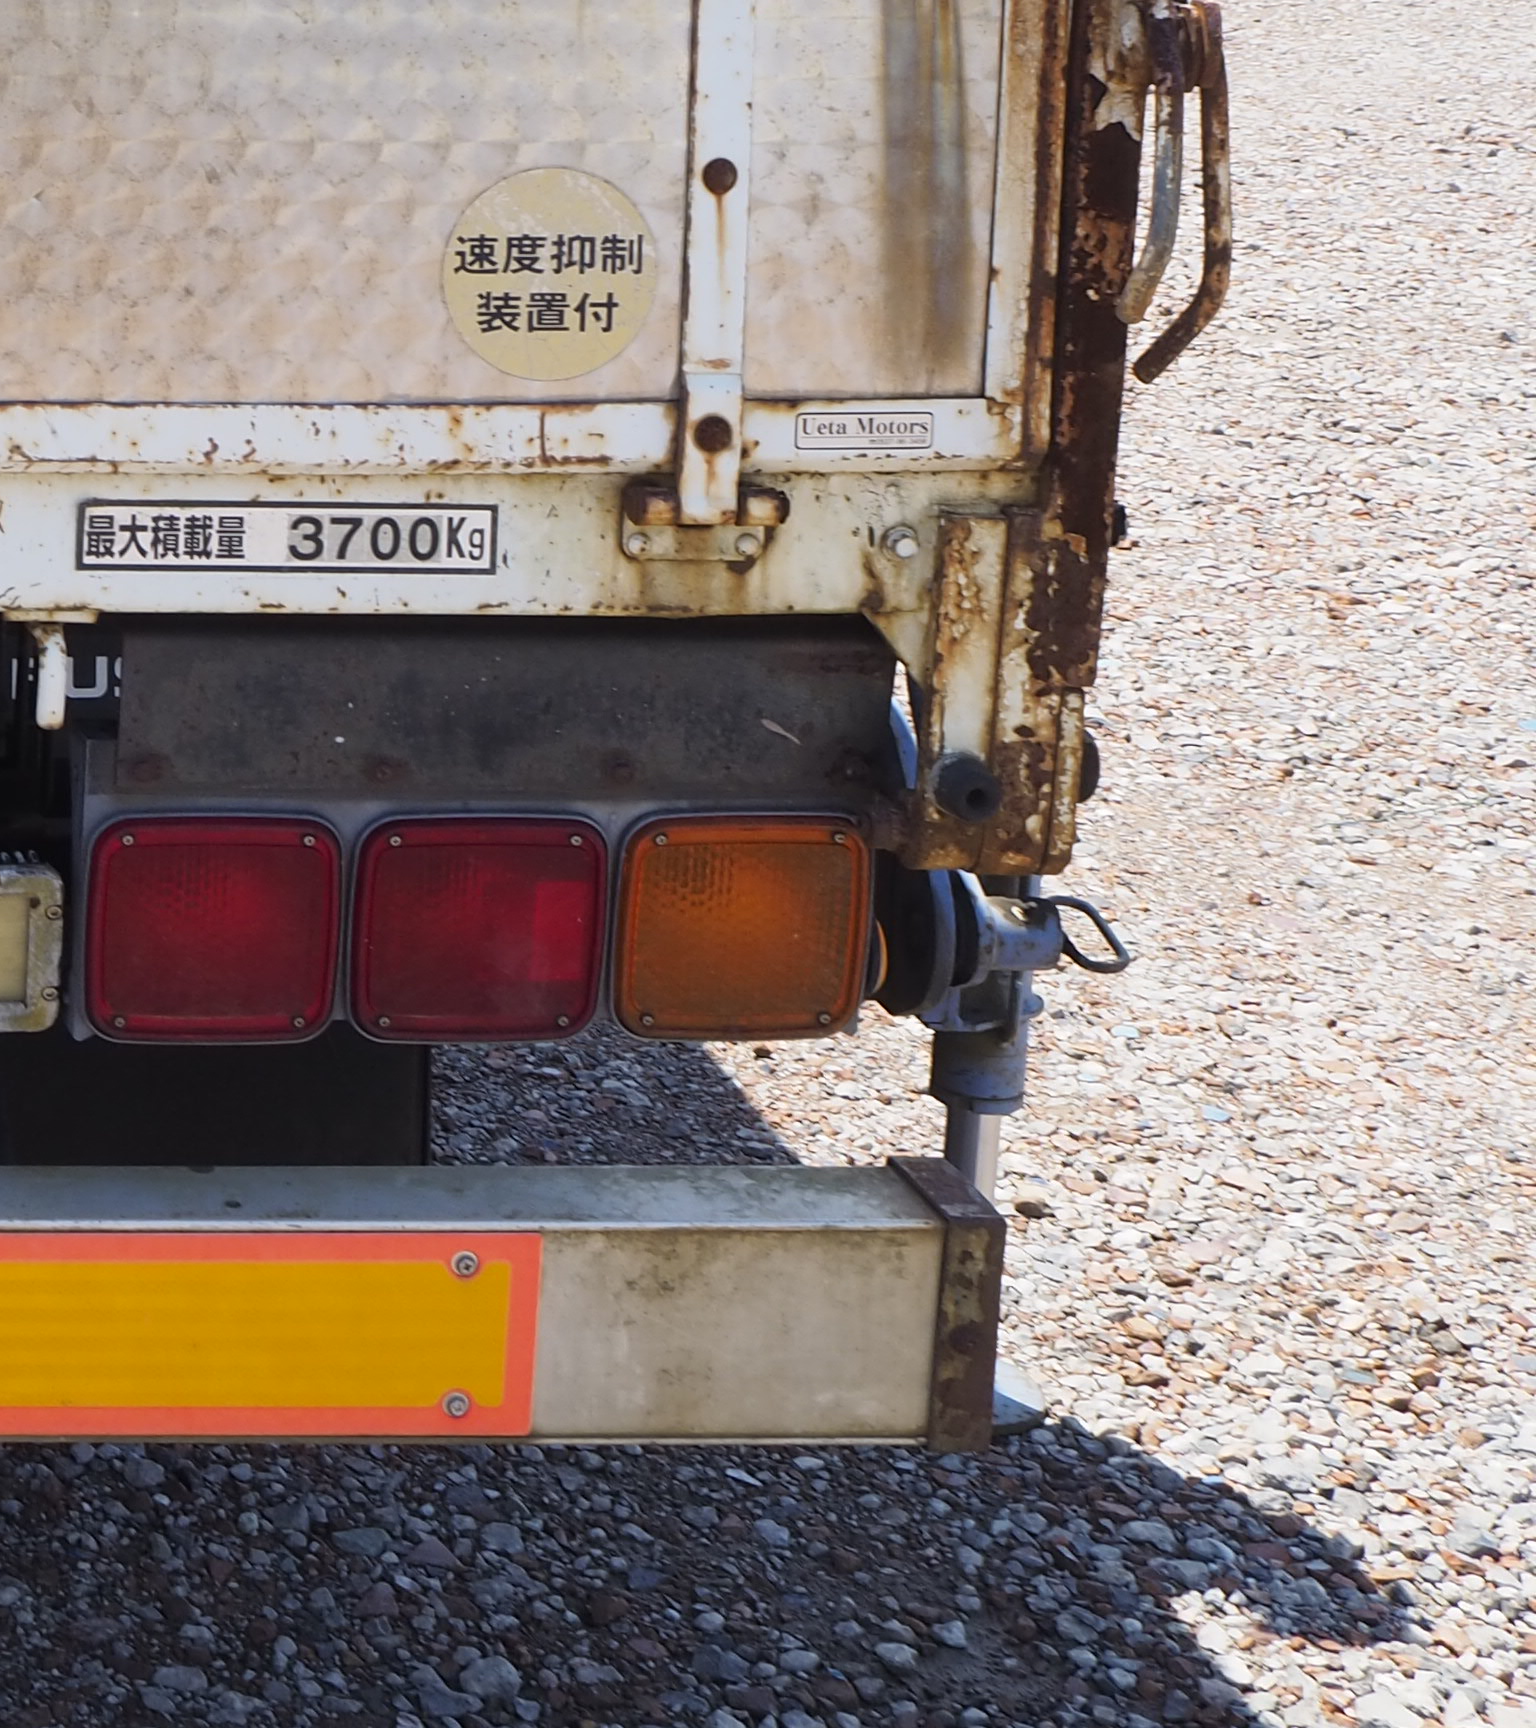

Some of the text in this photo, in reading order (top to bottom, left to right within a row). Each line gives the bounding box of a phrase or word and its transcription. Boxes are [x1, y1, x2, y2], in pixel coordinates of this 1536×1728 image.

[453, 233, 644, 275] 速度抑制
[476, 291, 620, 333] 装置付
[801, 417, 929, 435] Ueta Motors
[85, 514, 485, 561] 最大積載量 3700Kg
